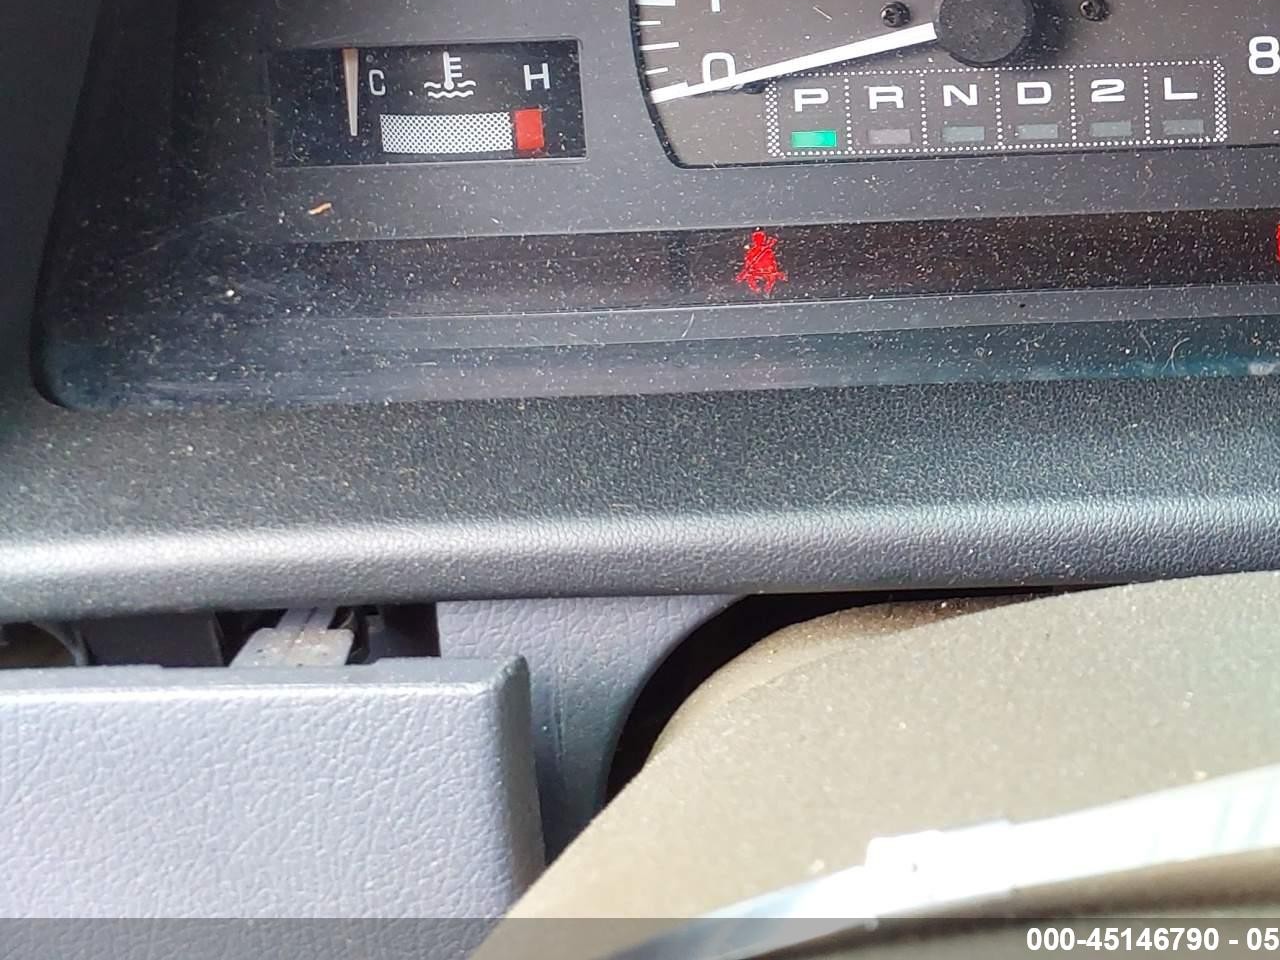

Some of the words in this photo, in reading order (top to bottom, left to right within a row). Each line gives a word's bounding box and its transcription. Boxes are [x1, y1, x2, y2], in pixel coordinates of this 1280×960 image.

[702, 52, 736, 87] 0
[1249, 36, 1280, 74] 8
[368, 69, 386, 96] C
[524, 63, 550, 90] H
[795, 89, 828, 112] P
[868, 86, 904, 109] R
[943, 85, 977, 106] N
[1017, 82, 1051, 104] D
[1091, 79, 1125, 102] 2
[1164, 78, 1197, 100] L
